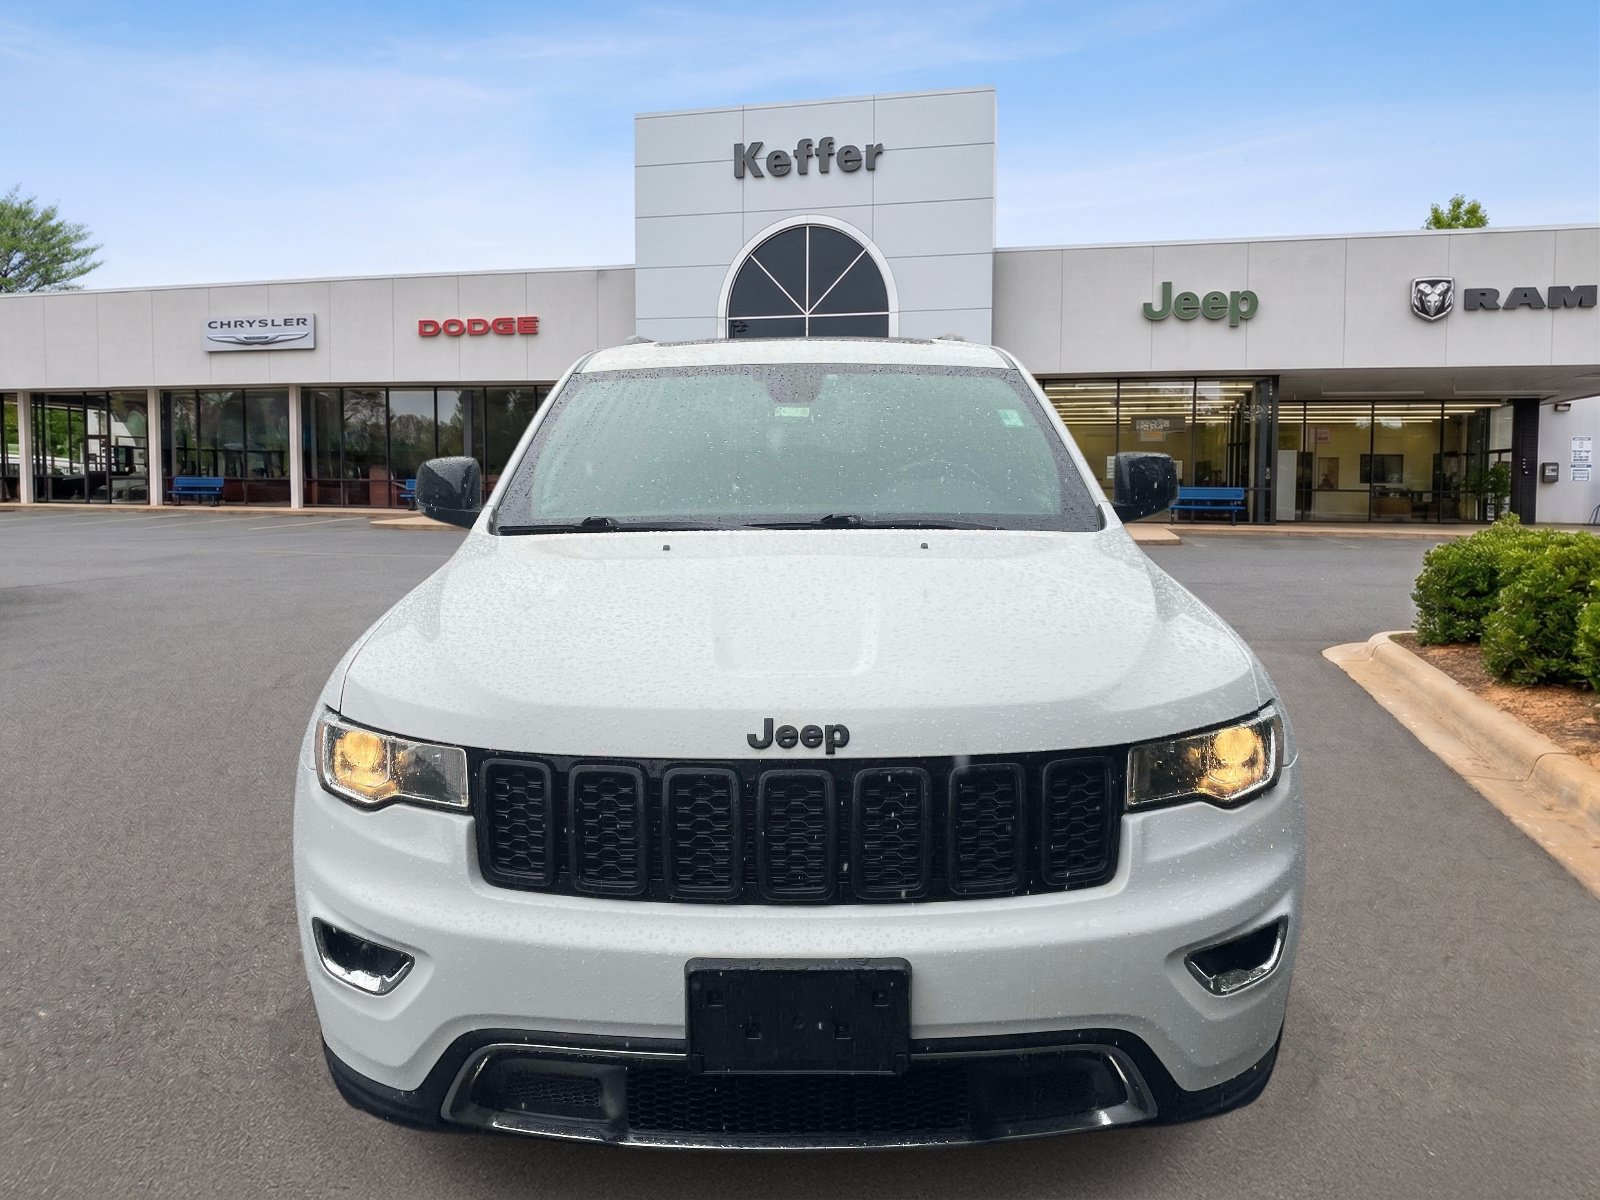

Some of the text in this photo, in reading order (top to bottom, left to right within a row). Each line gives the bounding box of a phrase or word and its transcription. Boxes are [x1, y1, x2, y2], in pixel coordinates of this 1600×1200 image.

[734, 137, 883, 178] Keffer
[1142, 281, 1259, 327] Jeep
[1464, 285, 1598, 310] RAM
[207, 318, 308, 329] CHRYSLER
[418, 316, 539, 337] DODGE
[747, 717, 850, 755] Jeep
